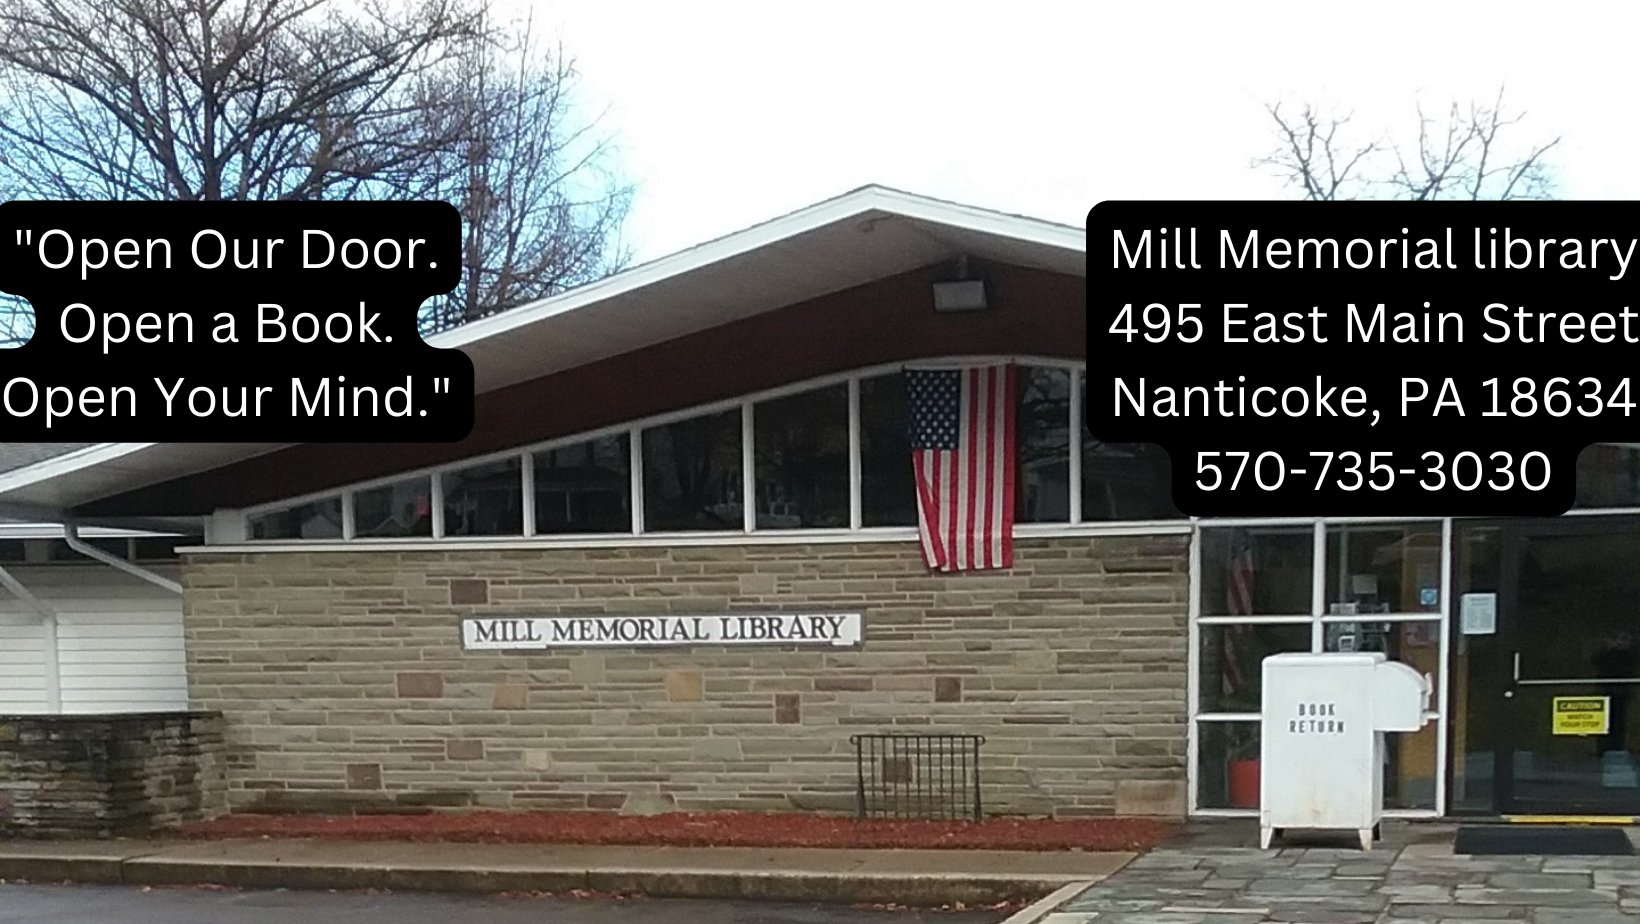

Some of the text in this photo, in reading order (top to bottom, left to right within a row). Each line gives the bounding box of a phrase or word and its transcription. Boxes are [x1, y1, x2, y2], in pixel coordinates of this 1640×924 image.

[475, 614, 847, 643] MILL MEMORIAL LIBRARY
[1299, 703, 1335, 716] BOOK
[1560, 702, 1601, 710] CAUTION
[1289, 720, 1344, 733] RETURN
